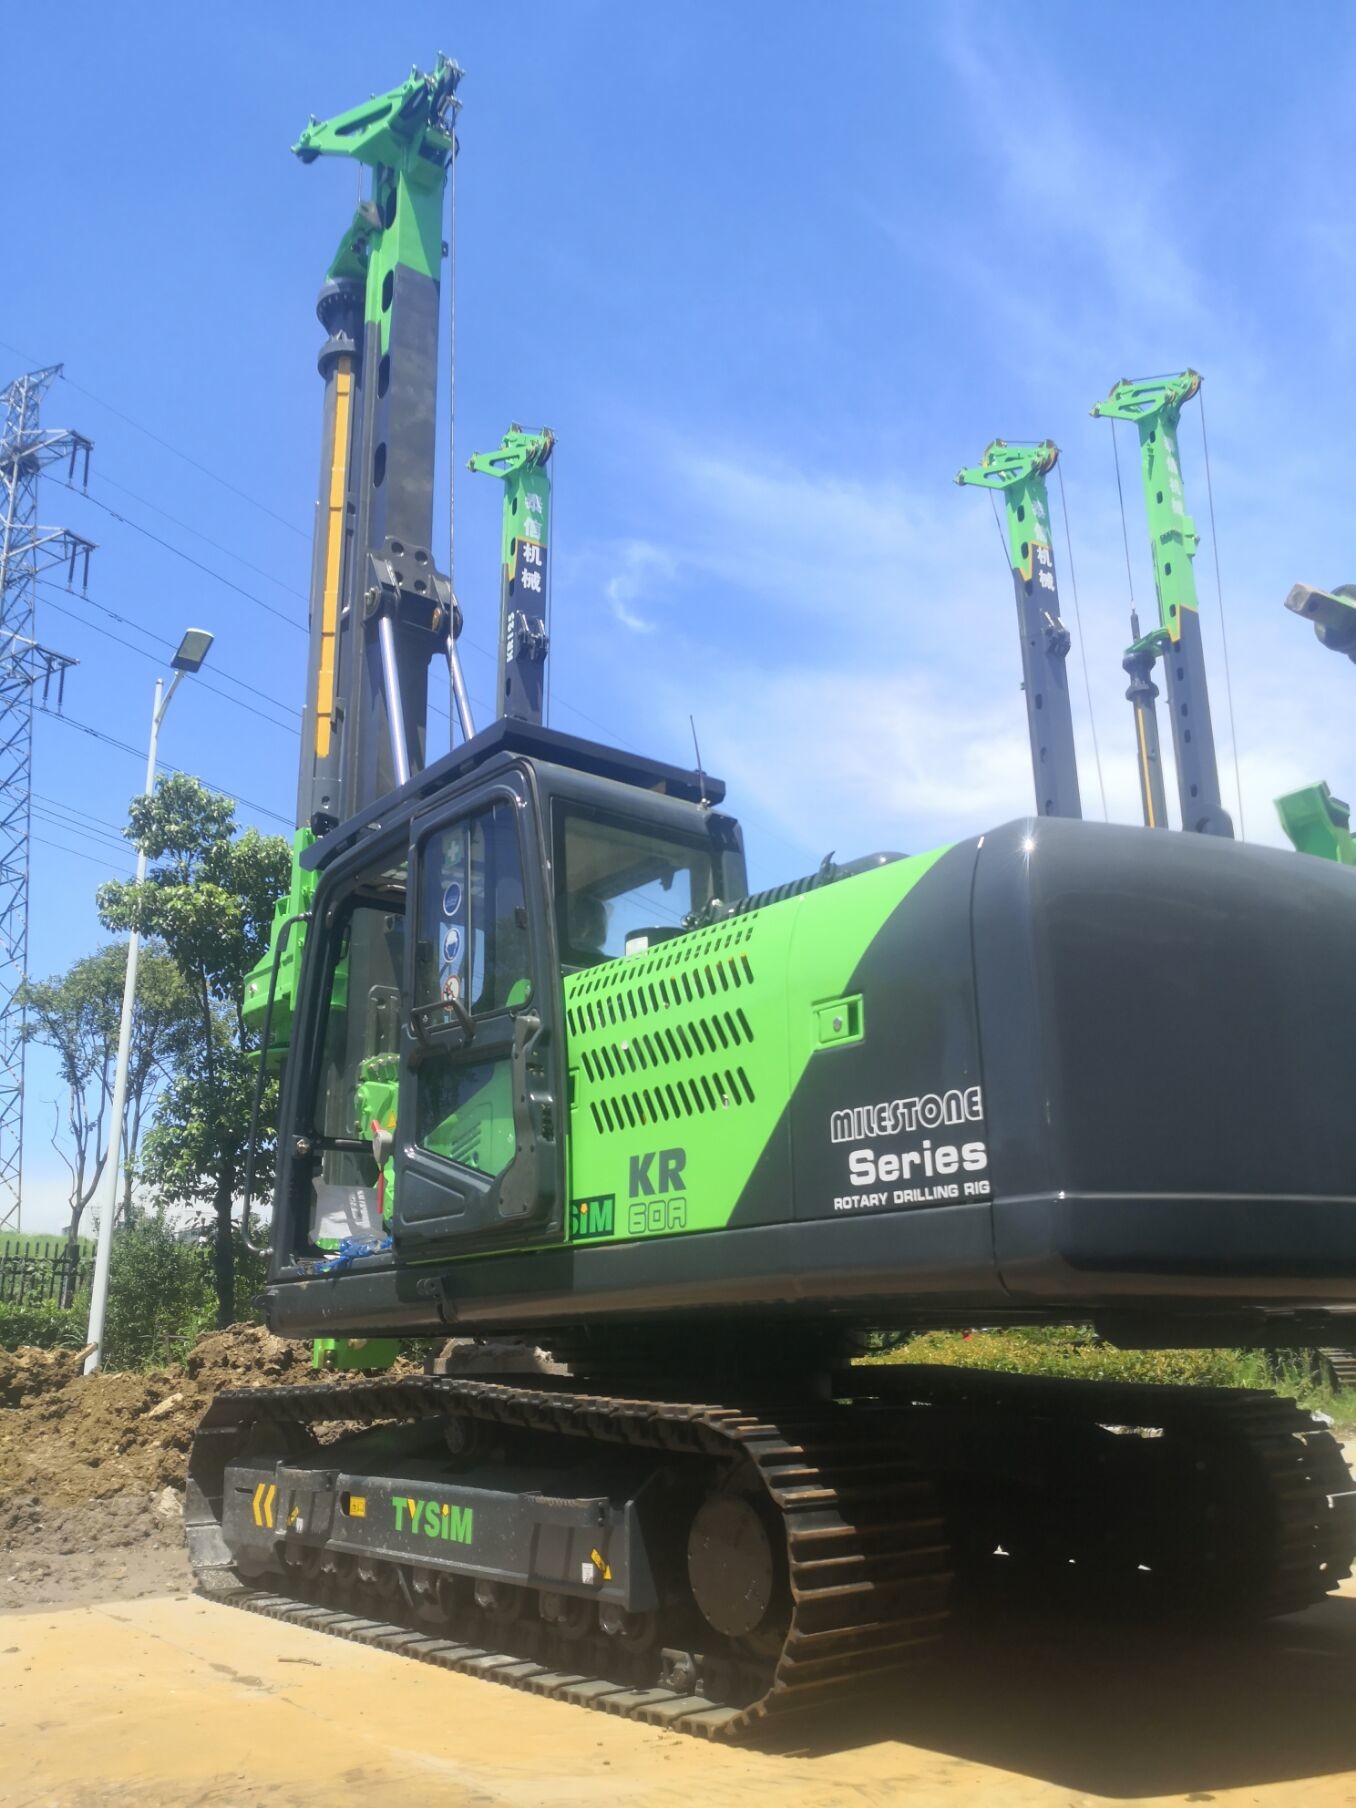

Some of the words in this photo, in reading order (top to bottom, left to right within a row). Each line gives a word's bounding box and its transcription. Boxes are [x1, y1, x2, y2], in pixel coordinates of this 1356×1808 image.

[831, 1086, 984, 1143] MILESTONE
[628, 1146, 687, 1198] KR
[848, 1139, 988, 1187] Series
[627, 1196, 687, 1235] 60A
[833, 1192, 888, 1211] ROTARY
[893, 1183, 959, 1204] DRILLING
[963, 1179, 991, 1196] RIG
